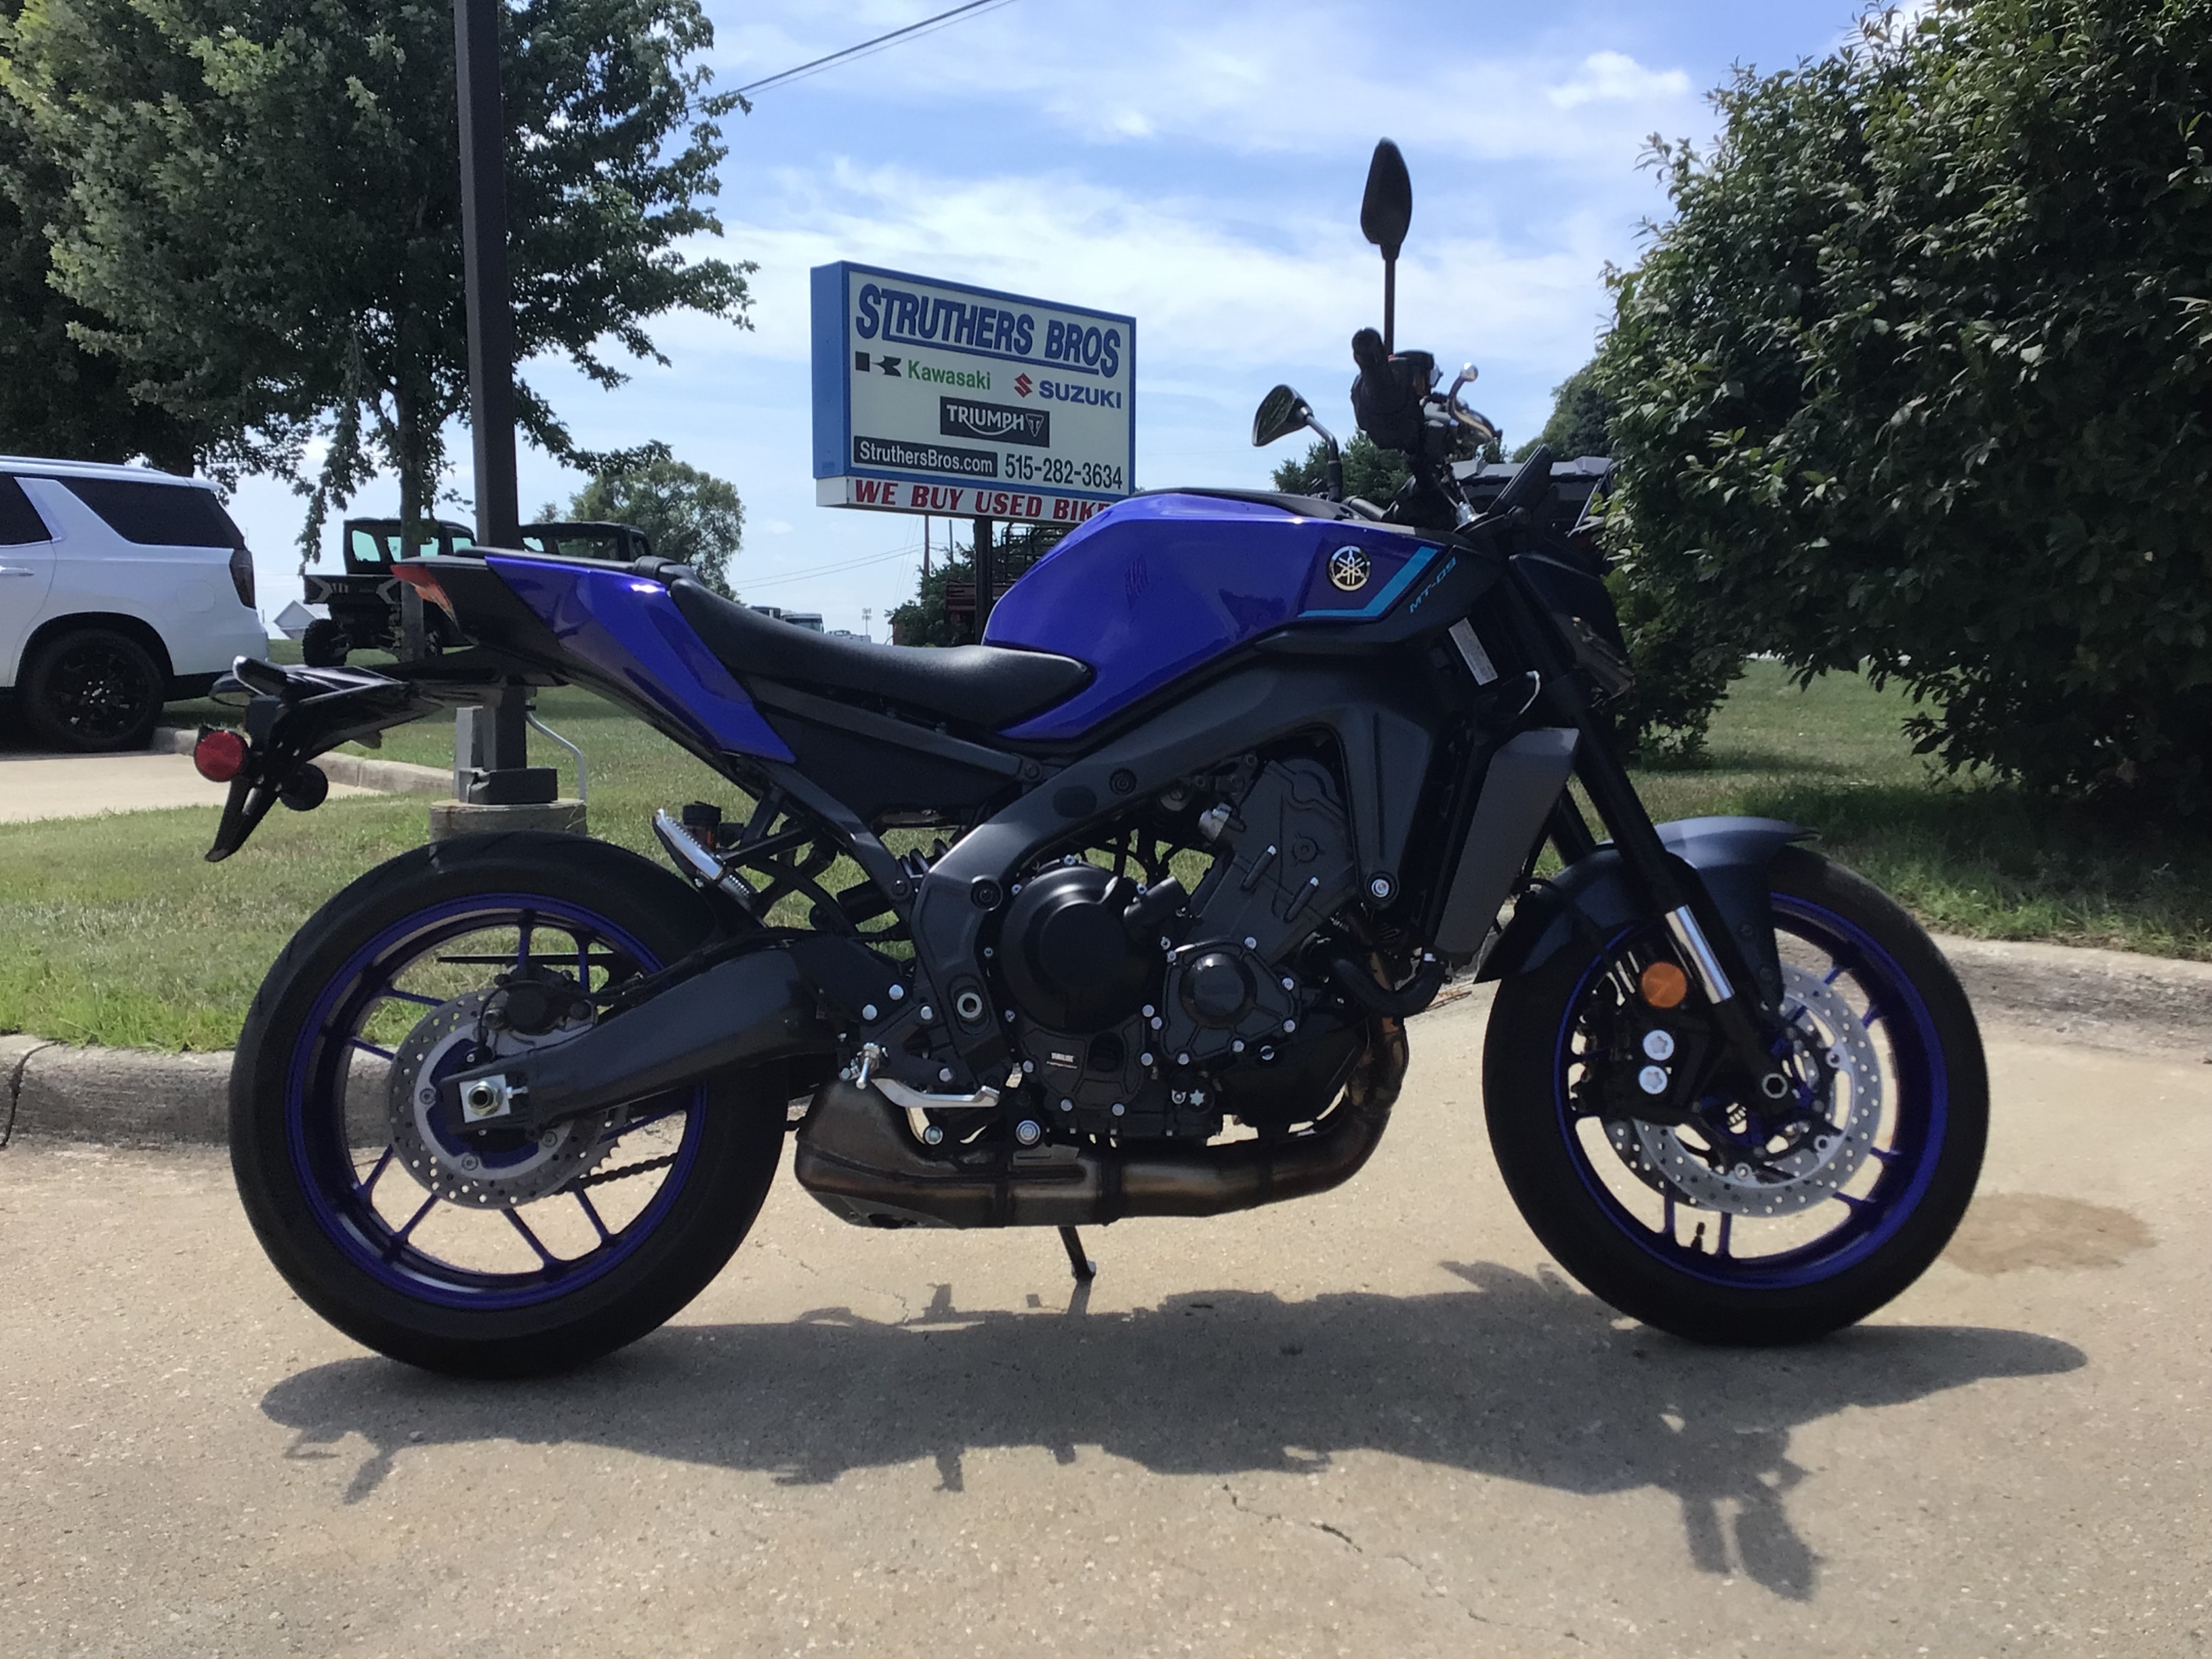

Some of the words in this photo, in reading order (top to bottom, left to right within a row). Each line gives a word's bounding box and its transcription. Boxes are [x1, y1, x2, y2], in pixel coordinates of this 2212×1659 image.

[855, 283, 1035, 355] STRUTHERS
[1044, 319, 1122, 378] BROS
[907, 359, 991, 390] Kawasaki
[1038, 380, 1122, 409] SUZUKI
[946, 404, 1025, 436] TRIUMPH
[859, 442, 993, 473] StruthersBros.com
[1004, 453, 1123, 490] 515-282-3634
[855, 479, 899, 506] WE
[910, 485, 964, 512] BUY
[975, 491, 1042, 518] USED
[1409, 556, 1457, 613] MT-09
